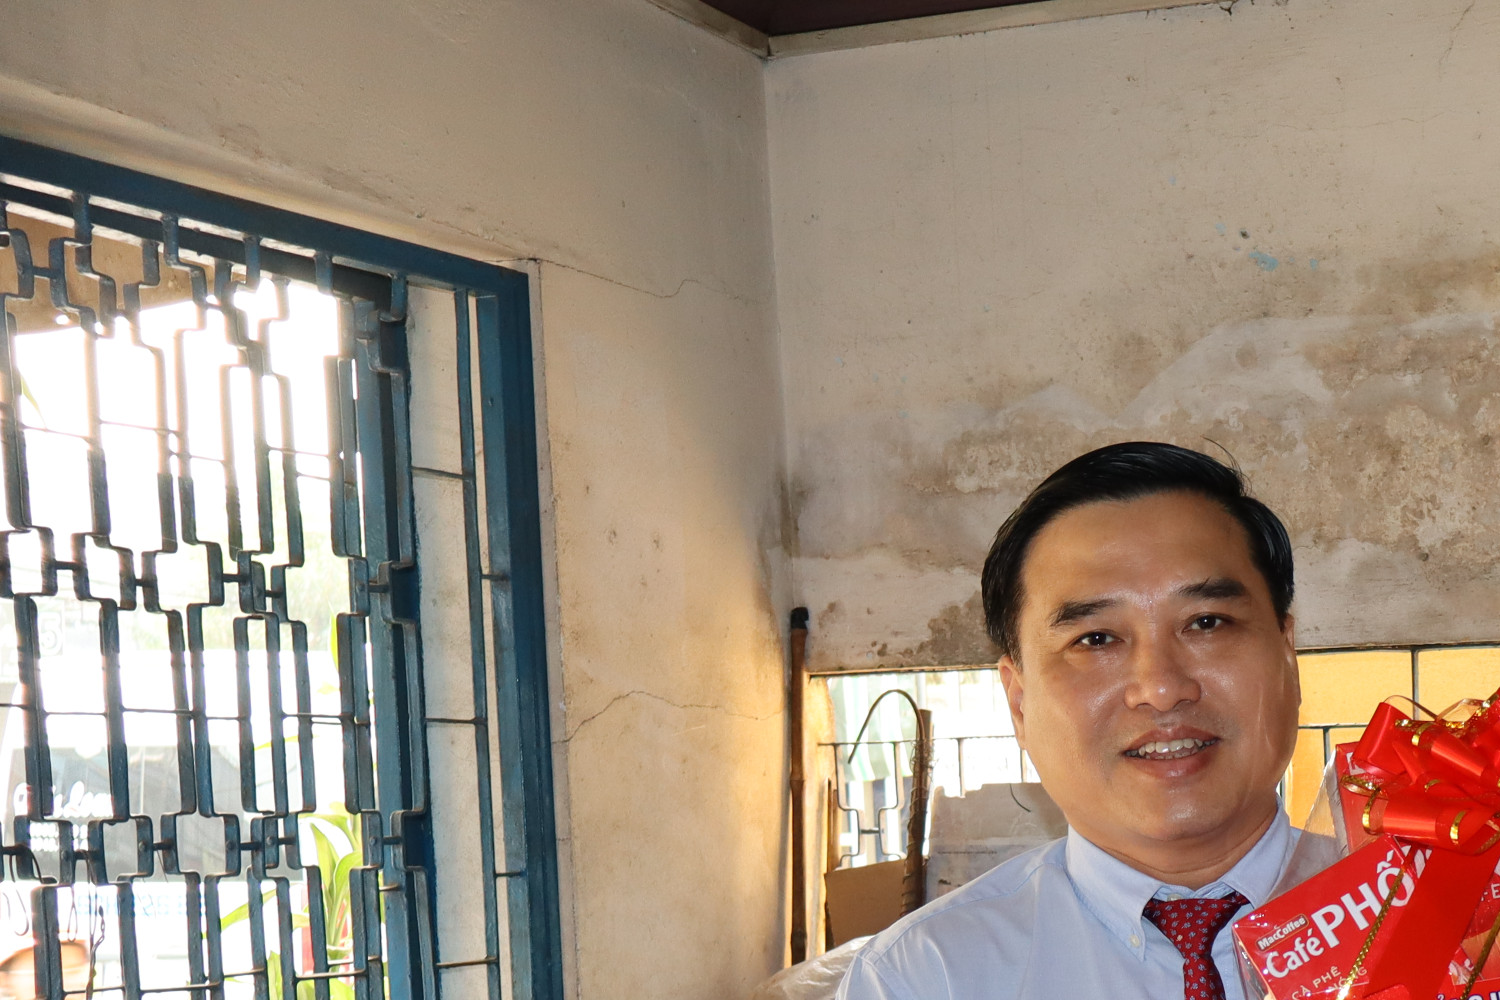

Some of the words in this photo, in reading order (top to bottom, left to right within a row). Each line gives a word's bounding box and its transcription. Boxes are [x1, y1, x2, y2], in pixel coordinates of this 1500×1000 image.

[1257, 917, 1306, 950] MacCoffee
[1266, 928, 1324, 978] Café
[1313, 965, 1341, 989] PHÊ
